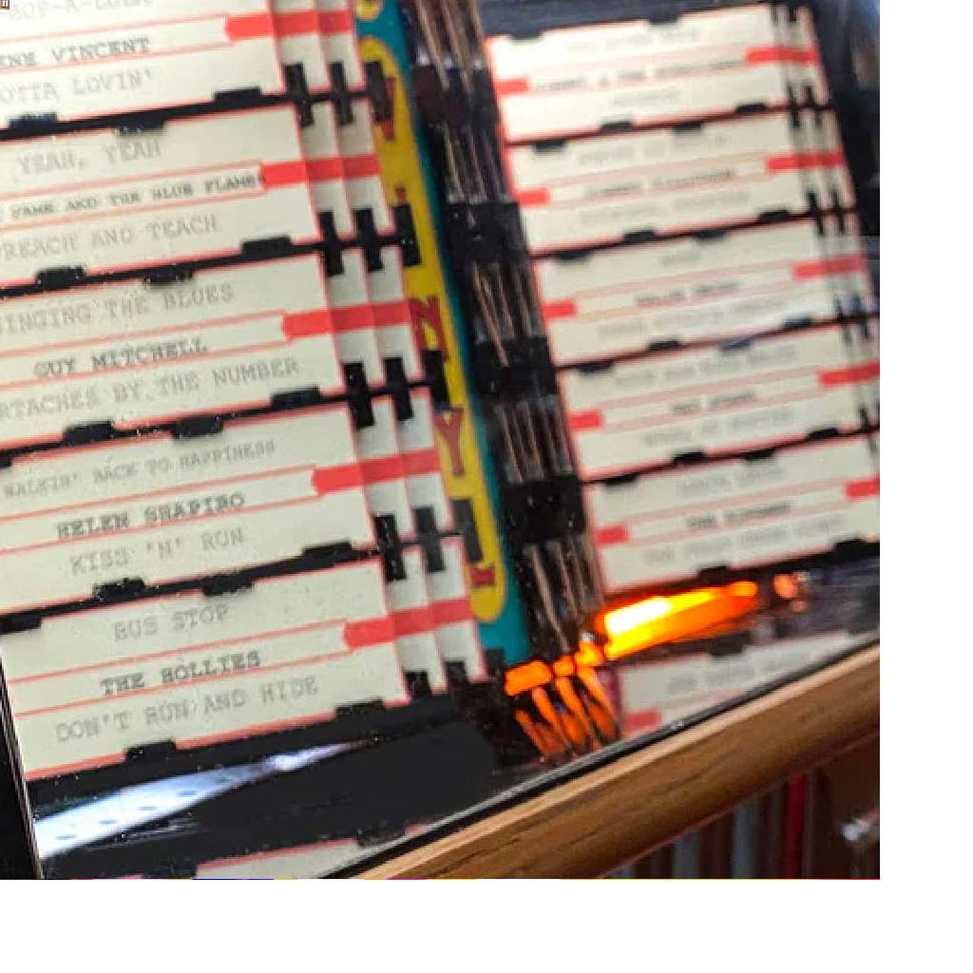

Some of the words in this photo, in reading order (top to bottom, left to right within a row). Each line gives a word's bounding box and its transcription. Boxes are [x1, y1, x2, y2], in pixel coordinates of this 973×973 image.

[50, 36, 151, 63] VINCENT
[104, 137, 162, 163] YEAH
[90, 226, 135, 249] AND
[146, 212, 220, 241] TEACH
[104, 291, 149, 318] THE
[163, 282, 235, 311] BLUES
[33, 357, 77, 377] GUY
[90, 337, 209, 372] MITCHELL
[113, 377, 142, 404] BY
[155, 370, 200, 394] THE
[211, 355, 300, 387] NUMBER
[144, 457, 171, 475] TO
[178, 438, 276, 469] HAPPINESS
[55, 511, 130, 540] HELEN
[143, 491, 246, 522] SHAPIRO
[70, 546, 131, 575] KISS
[200, 526, 244, 552] RUN
[113, 616, 159, 643] BUS
[171, 602, 231, 632] STOP
[99, 671, 146, 696] THE
[159, 649, 261, 684] HOLLIES
[54, 711, 133, 744] DON'T
[143, 701, 191, 726] RUN
[203, 688, 248, 716] AND
[259, 676, 321, 705] HIDE
